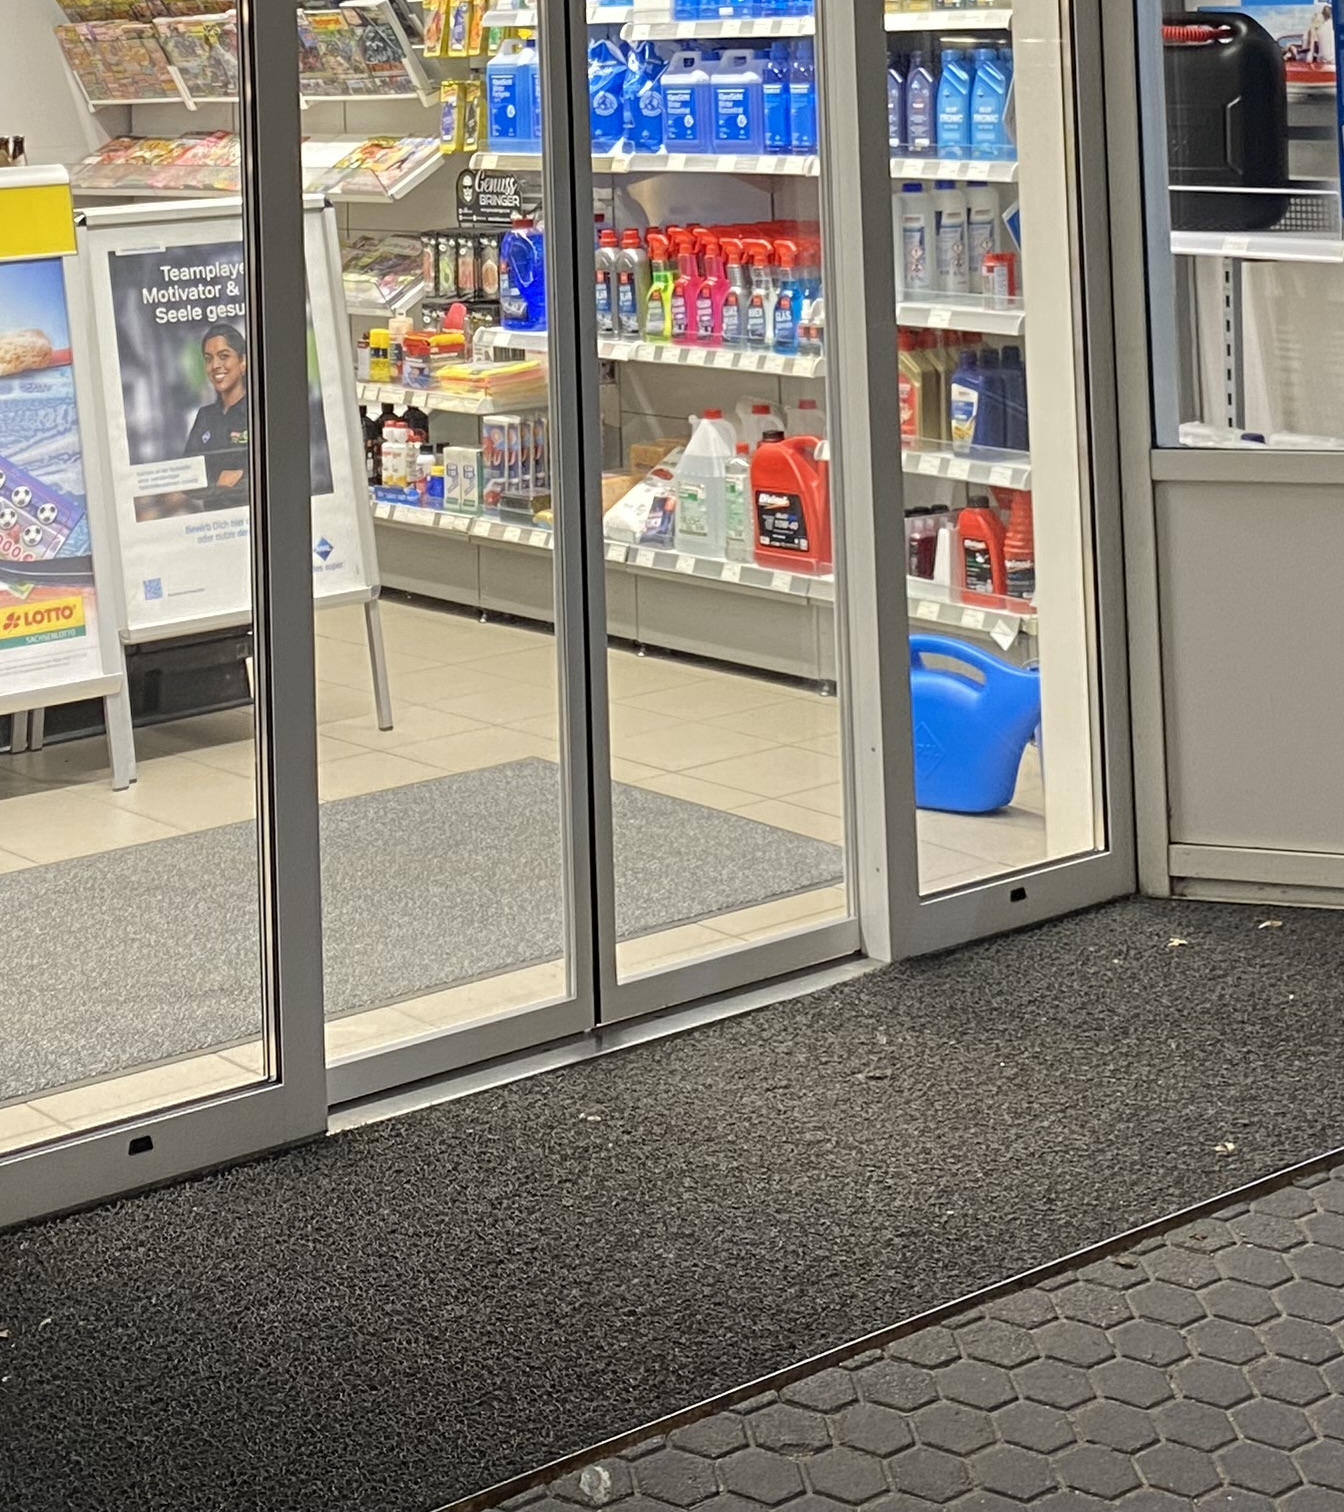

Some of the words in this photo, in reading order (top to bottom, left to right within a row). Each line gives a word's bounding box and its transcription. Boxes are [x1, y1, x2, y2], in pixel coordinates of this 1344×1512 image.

[475, 170, 517, 195] Genuss
[479, 193, 520, 207] BRINGER
[142, 283, 222, 305] Motivator
[226, 281, 241, 297] &
[155, 304, 202, 324] Seele
[206, 302, 245, 322] gesu
[23, 605, 74, 627] LOTTO
